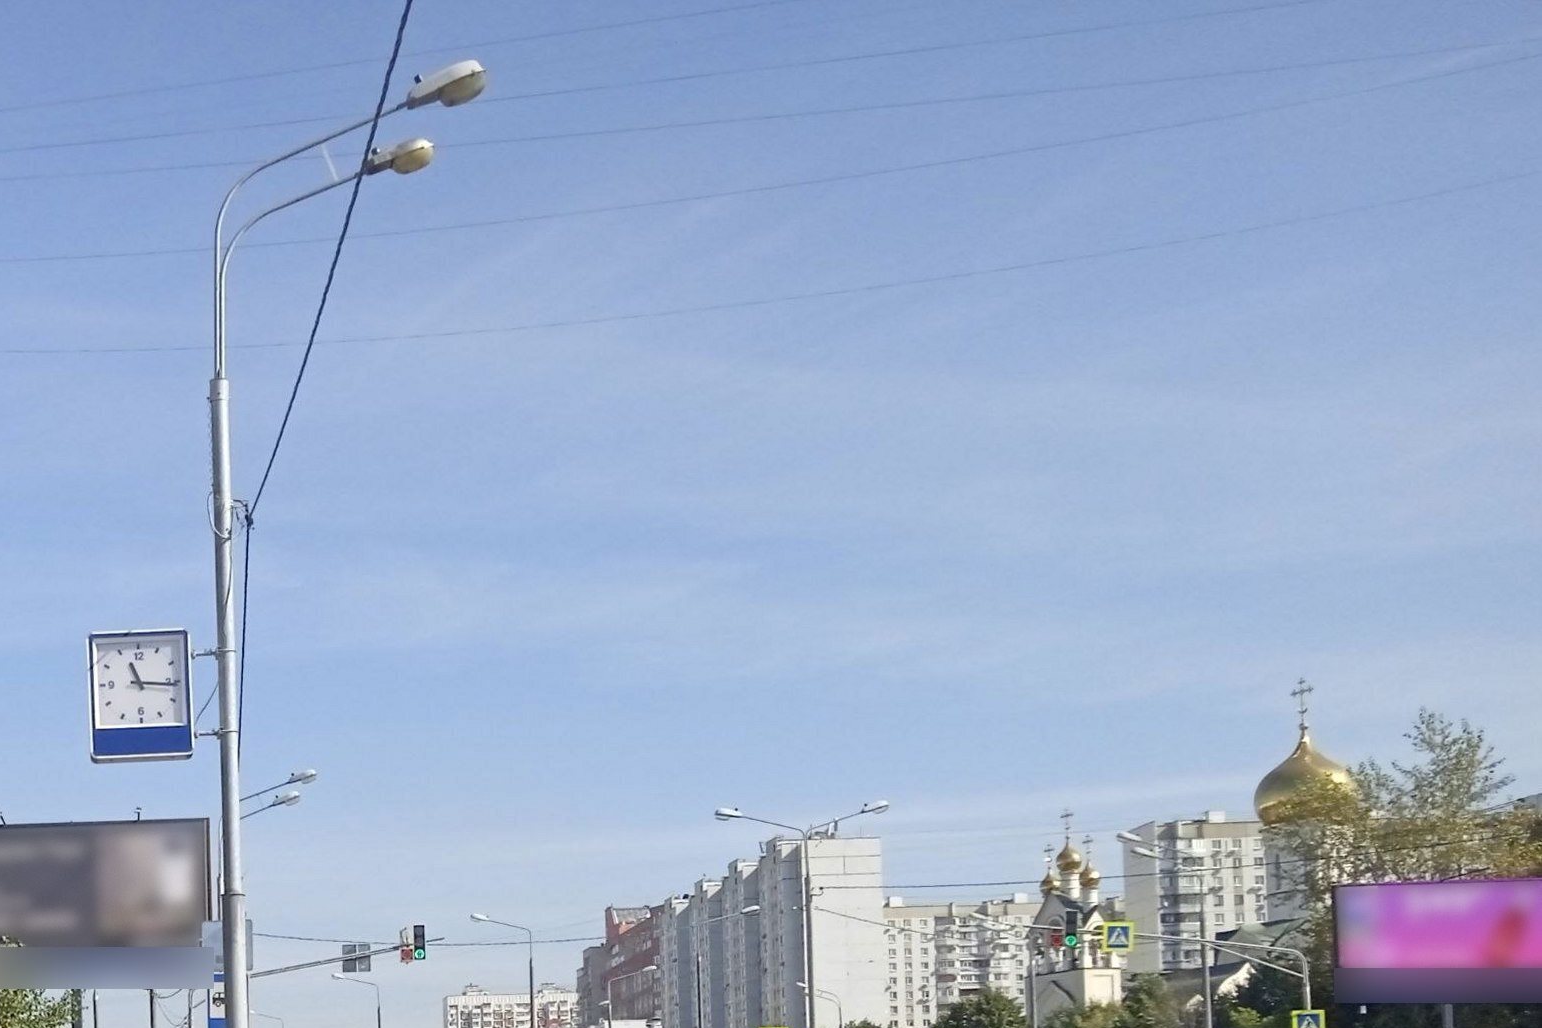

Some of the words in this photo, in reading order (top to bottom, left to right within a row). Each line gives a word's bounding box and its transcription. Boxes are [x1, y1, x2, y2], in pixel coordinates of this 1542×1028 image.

[134, 652, 145, 661] 12
[108, 681, 115, 690] 9
[137, 706, 145, 715] 6
